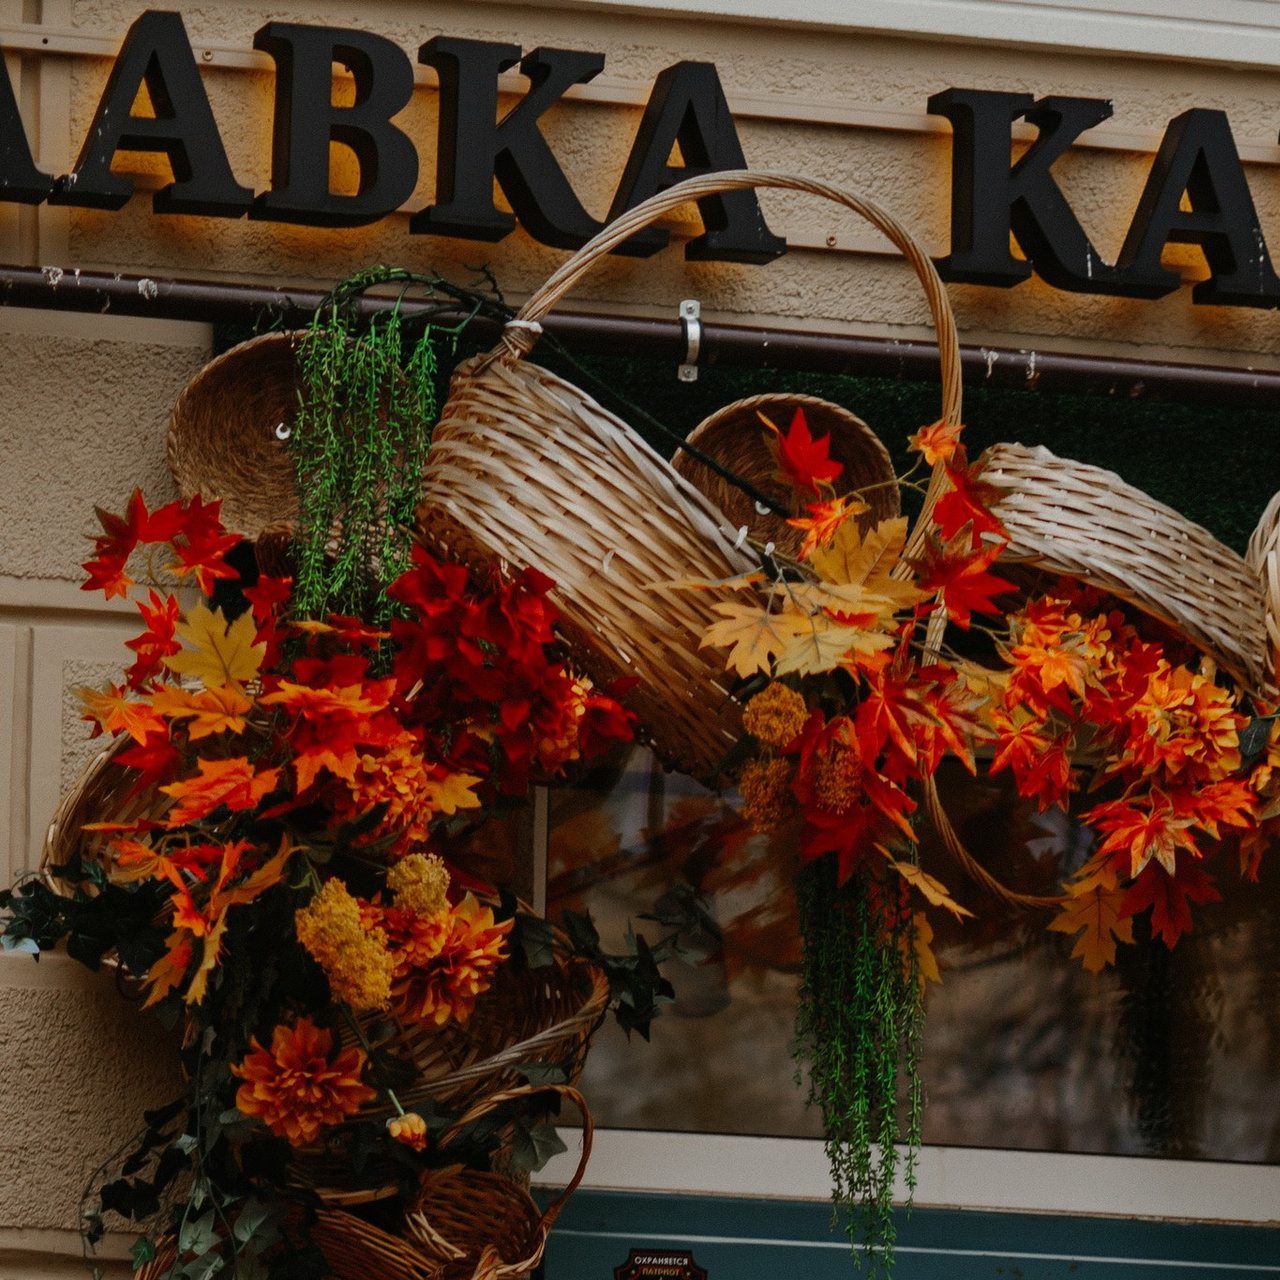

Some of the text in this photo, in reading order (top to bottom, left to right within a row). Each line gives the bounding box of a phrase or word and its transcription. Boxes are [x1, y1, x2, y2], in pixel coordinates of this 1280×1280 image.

[0, 10, 786, 265] АВКА
[634, 1256, 689, 1266] ОХРАНЯЕТСЯ
[642, 1267, 680, 1276] ПАТРИОТ
